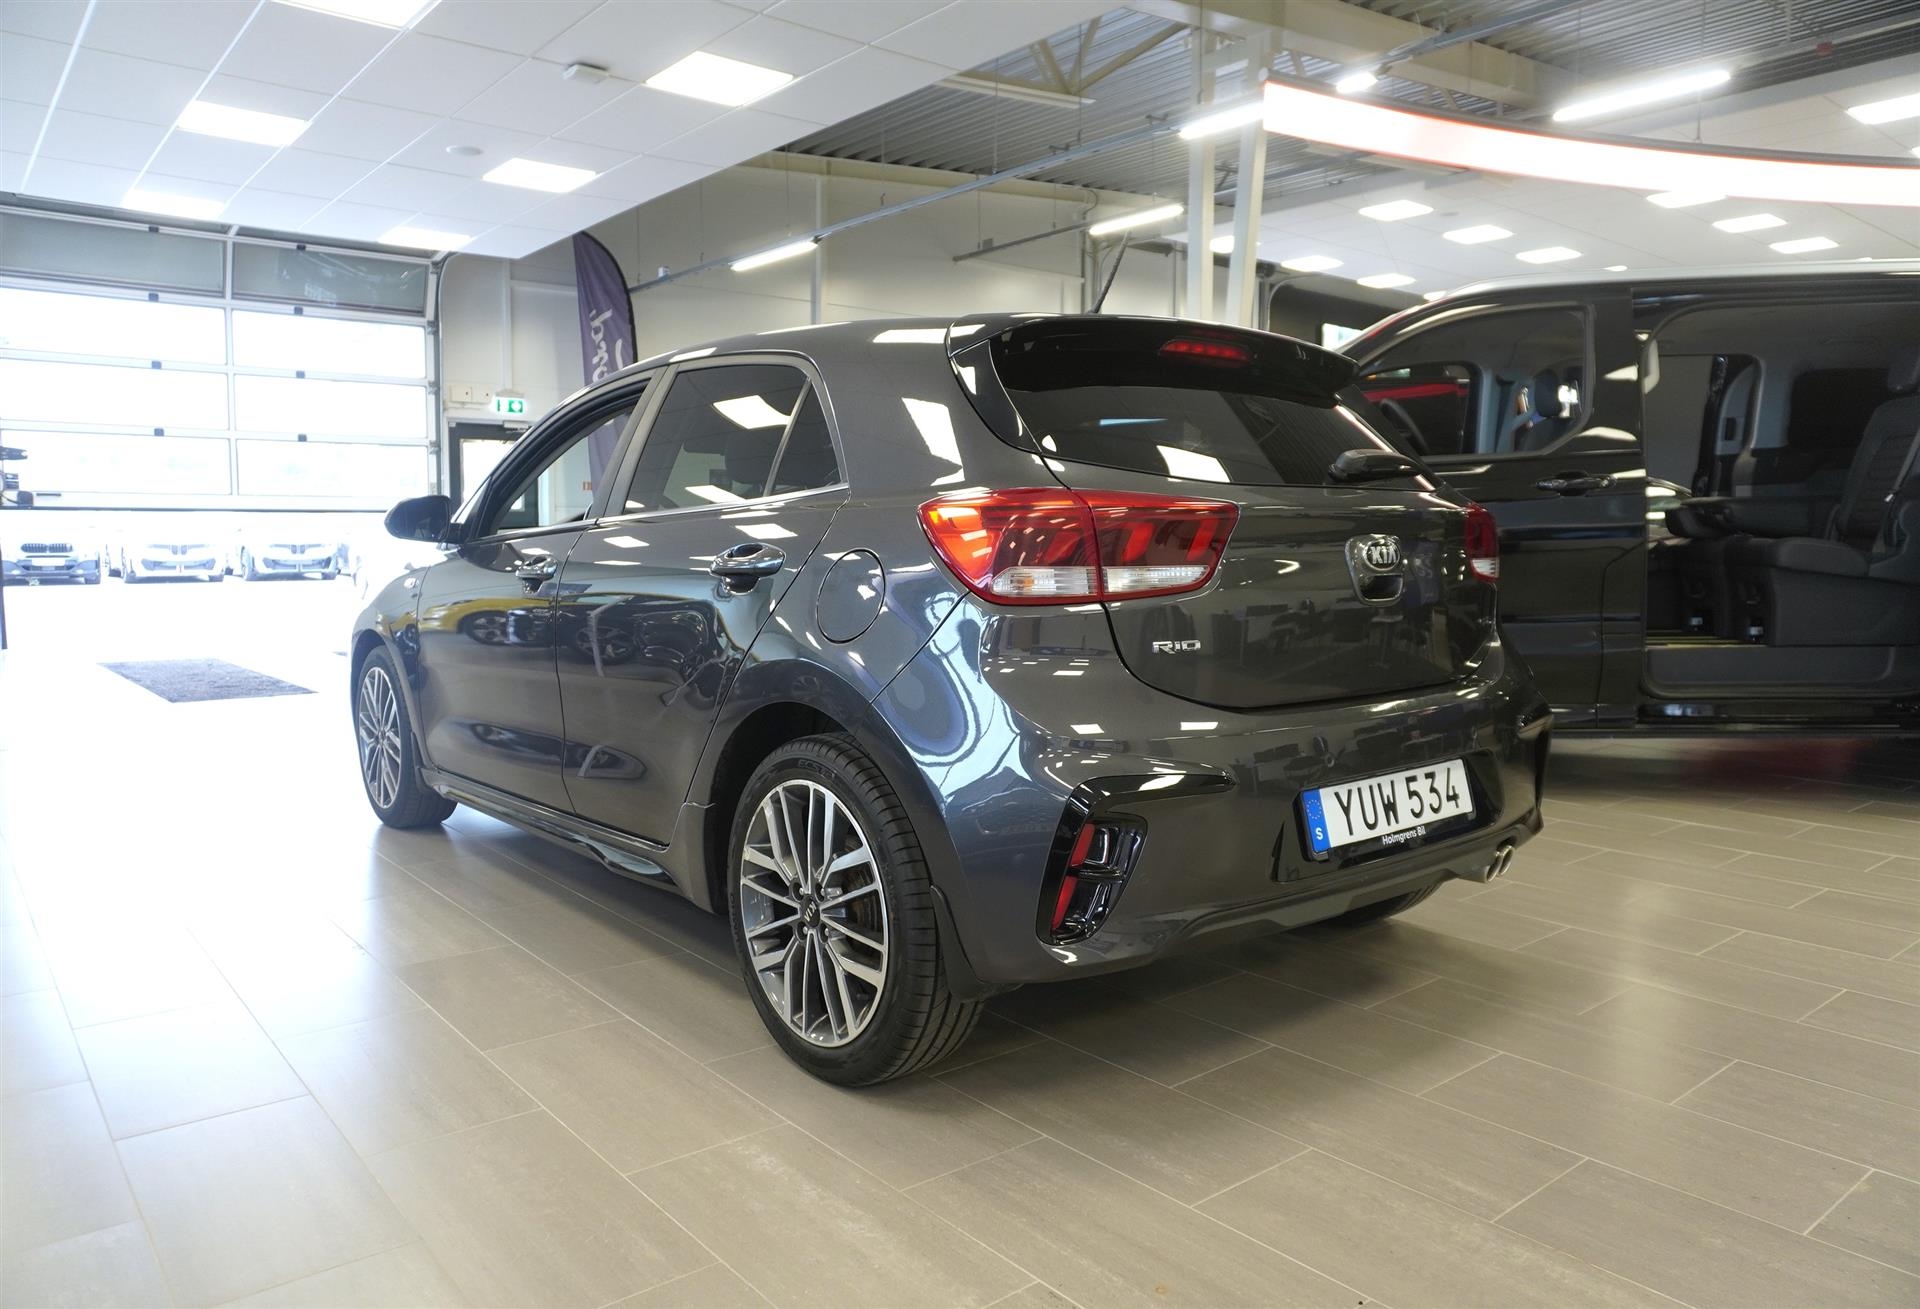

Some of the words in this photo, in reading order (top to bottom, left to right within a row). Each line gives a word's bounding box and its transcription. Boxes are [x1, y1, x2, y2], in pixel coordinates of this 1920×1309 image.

[1370, 545, 1397, 564] KIA
[1152, 640, 1201, 654] RIO
[1334, 780, 1400, 836] YUW
[1405, 767, 1460, 819] 534
[1315, 827, 1324, 840] S
[1382, 830, 1417, 845] Holmgrens
[1417, 825, 1426, 836] Bil
[804, 901, 817, 922] KIA
